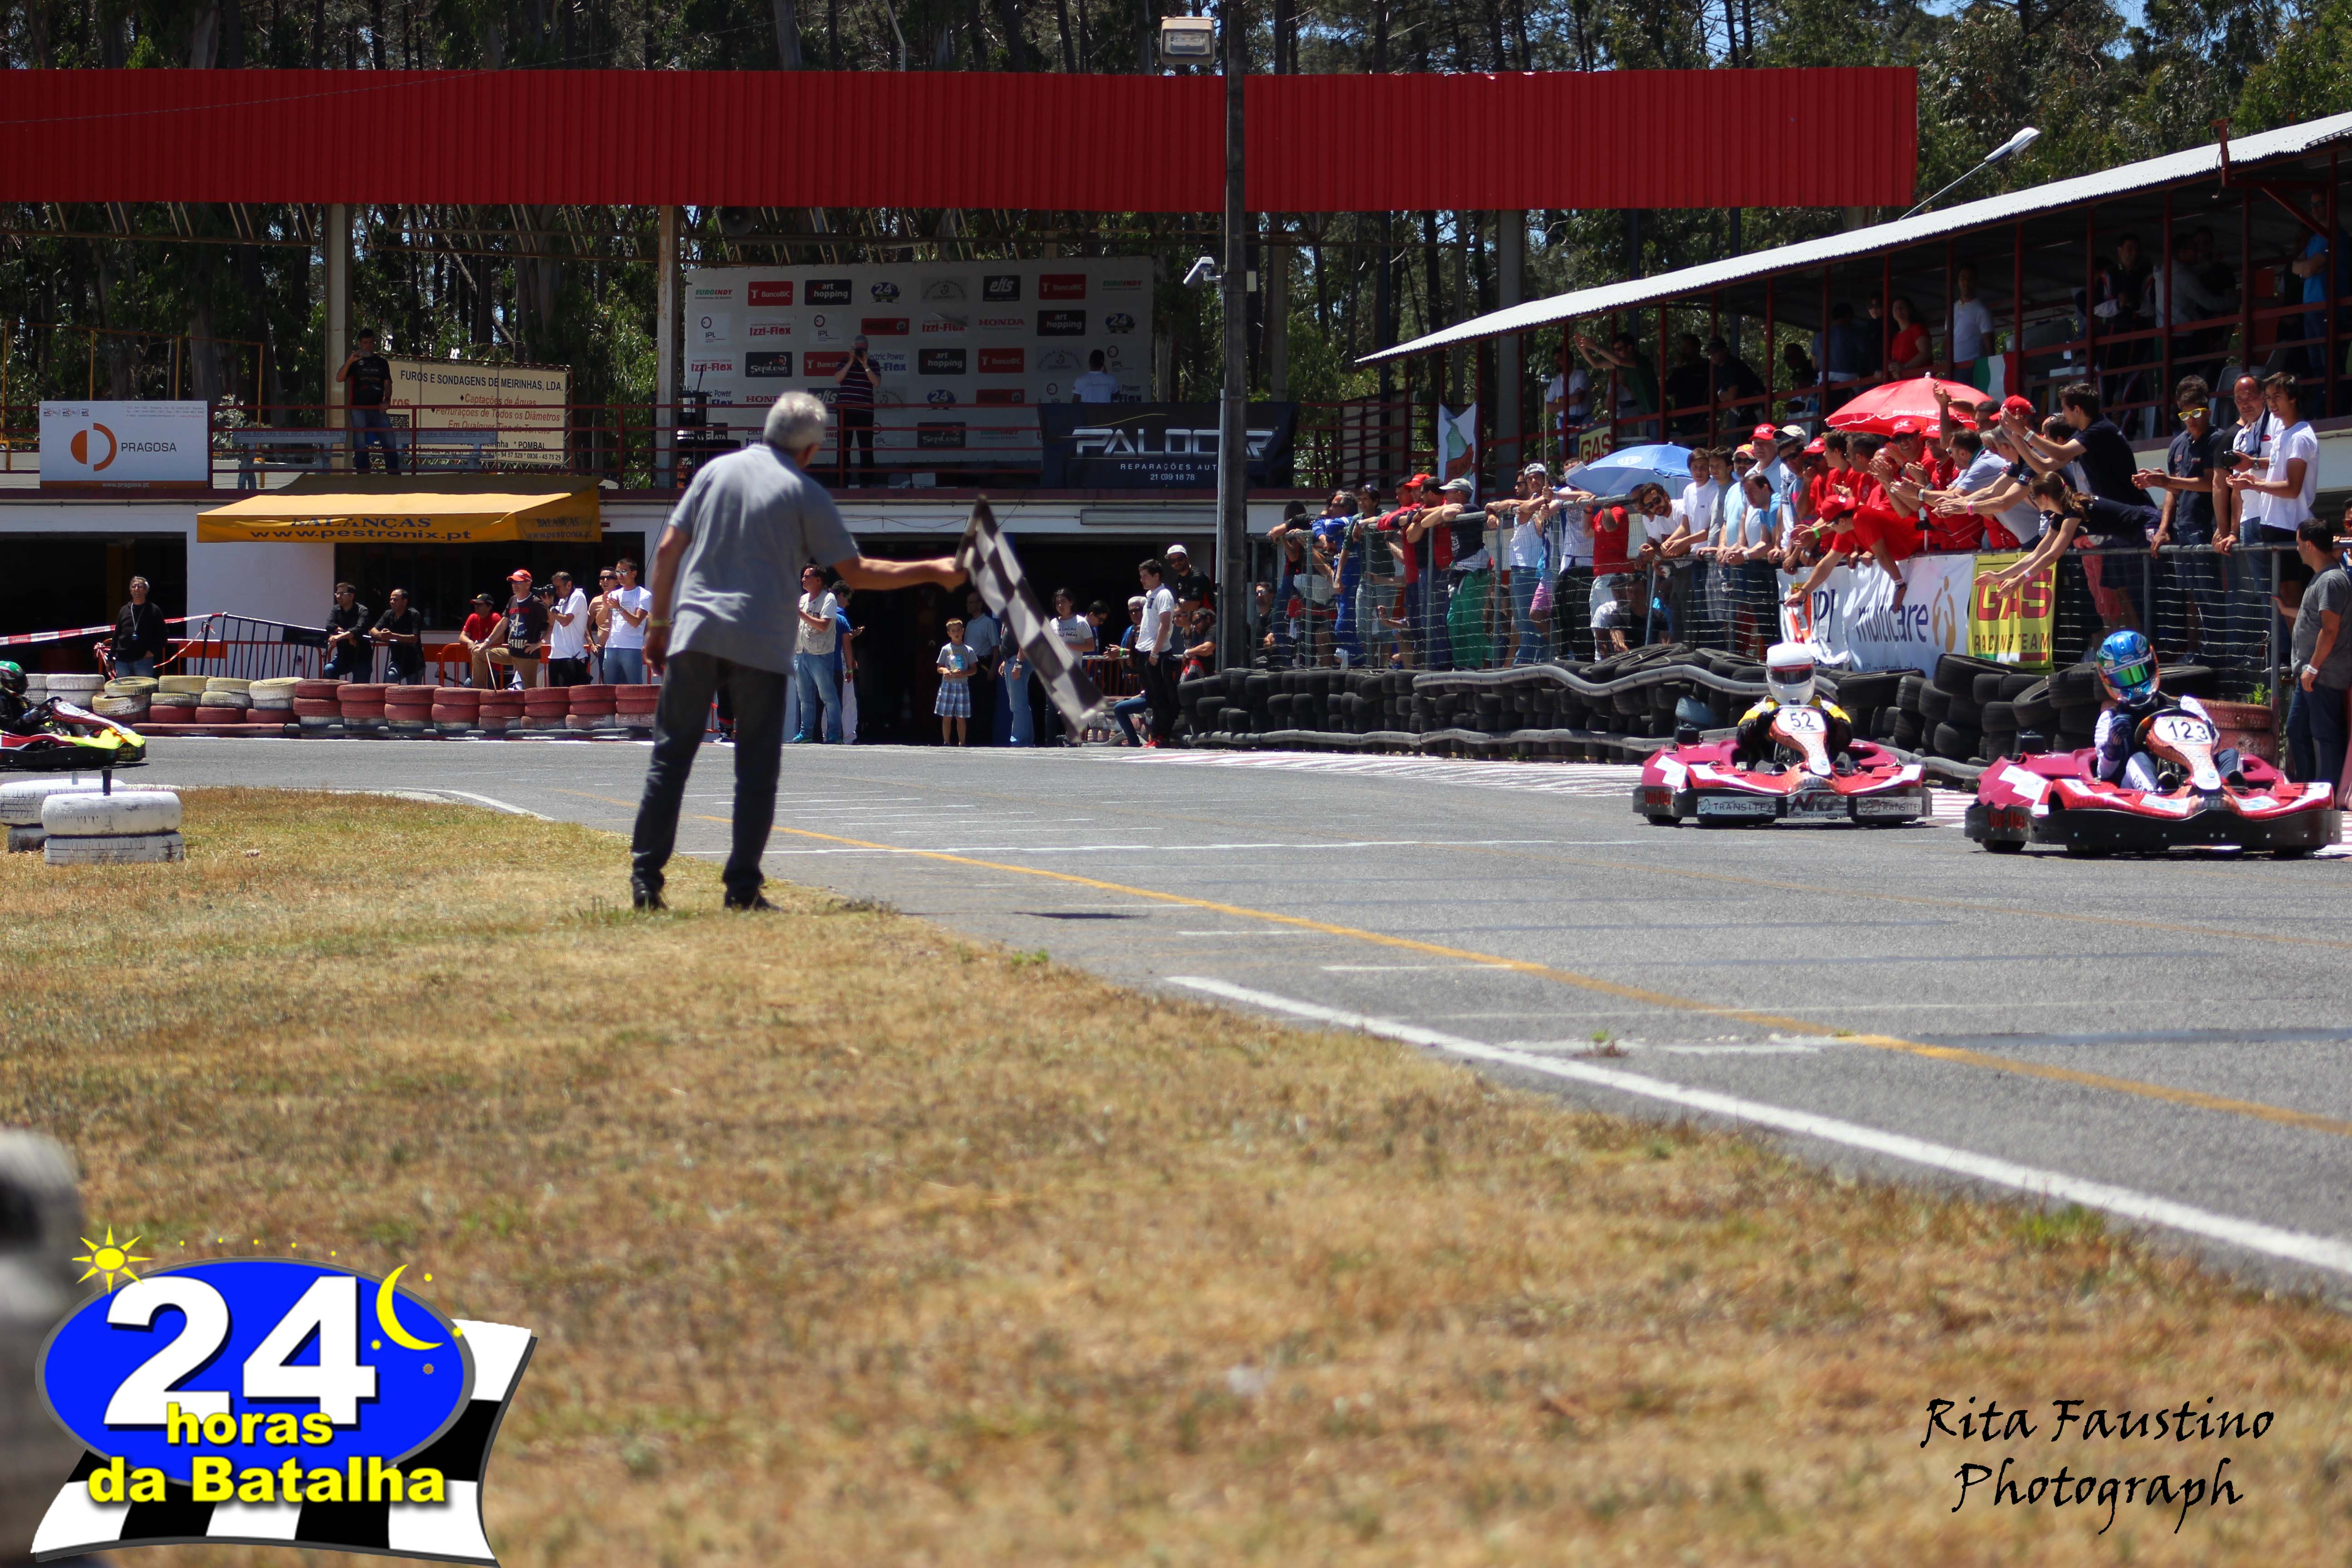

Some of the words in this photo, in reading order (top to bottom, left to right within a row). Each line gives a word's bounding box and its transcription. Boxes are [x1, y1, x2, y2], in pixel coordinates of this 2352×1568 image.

[873, 284, 892, 294] 24
[1110, 313, 1127, 325] 24
[401, 370, 428, 383] FUROS
[430, 374, 436, 383] E
[437, 375, 486, 387] SONDAGENS
[488, 377, 499, 387] DE
[501, 378, 544, 392] MEIRINHAS,
[546, 381, 564, 392] LDA.
[1122, 384, 1141, 392] Power
[465, 393, 502, 405] Captações
[930, 391, 949, 402] 24
[480, 408, 490, 417] de
[491, 409, 513, 418] Todos
[524, 411, 560, 421] Diâmetros
[121, 443, 177, 452] PRAGOSA
[518, 441, 546, 450] POMBAL
[1072, 428, 1274, 459] PALOCR
[1580, 433, 1612, 465] GAS
[1120, 461, 1191, 471] REPARAÇÕES
[291, 517, 432, 529] BALANÇAS
[250, 529, 471, 541] www.pestronix.pt
[1976, 568, 2053, 621] GAS
[1974, 634, 2014, 652] RACING
[2018, 632, 2050, 650] TEAM
[1789, 711, 1815, 727] 52
[2168, 721, 2209, 740] 123
[1713, 802, 1773, 813] TRANSITEX
